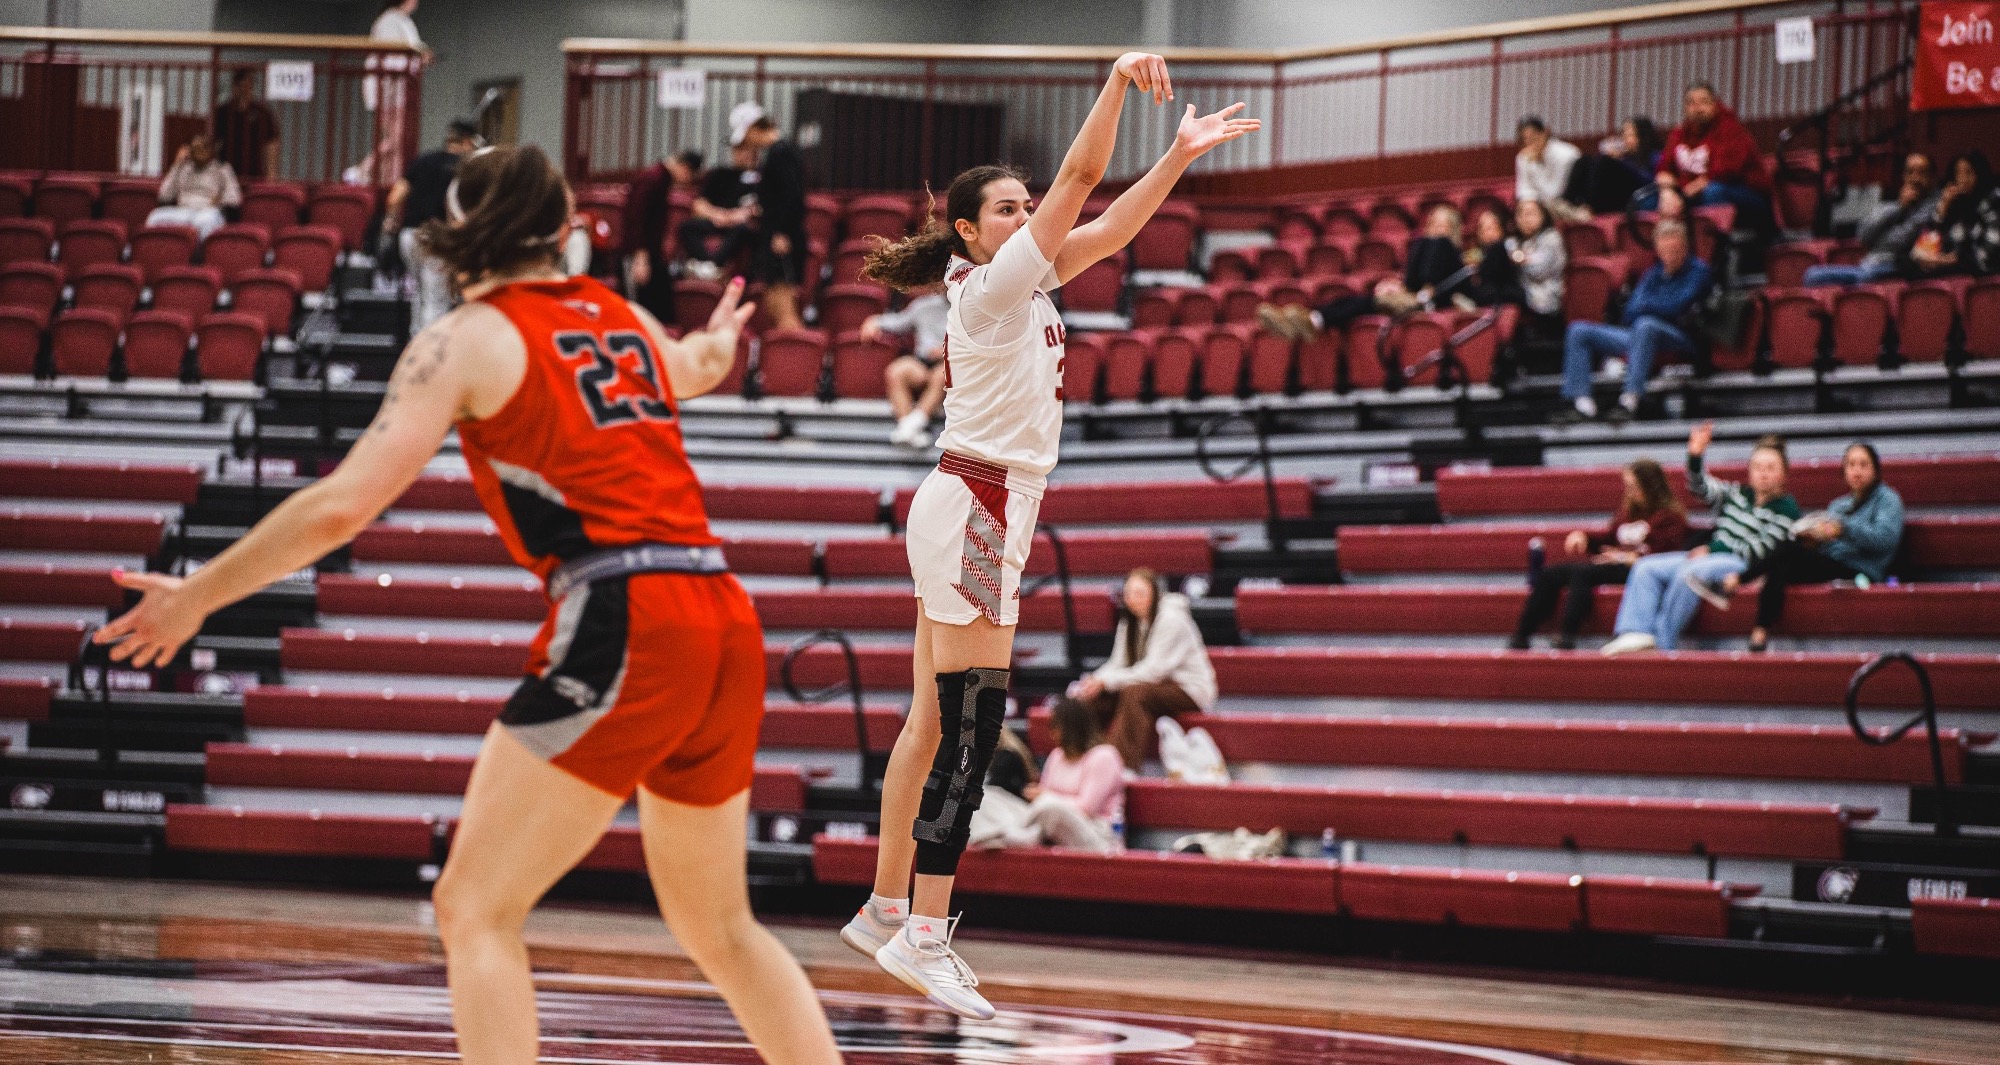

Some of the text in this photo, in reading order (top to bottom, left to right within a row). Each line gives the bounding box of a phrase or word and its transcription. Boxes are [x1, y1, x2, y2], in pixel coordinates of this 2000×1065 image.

[1936, 12, 1993, 47] Join
[1946, 61, 1984, 94] Be
[551, 329, 678, 430] 23
